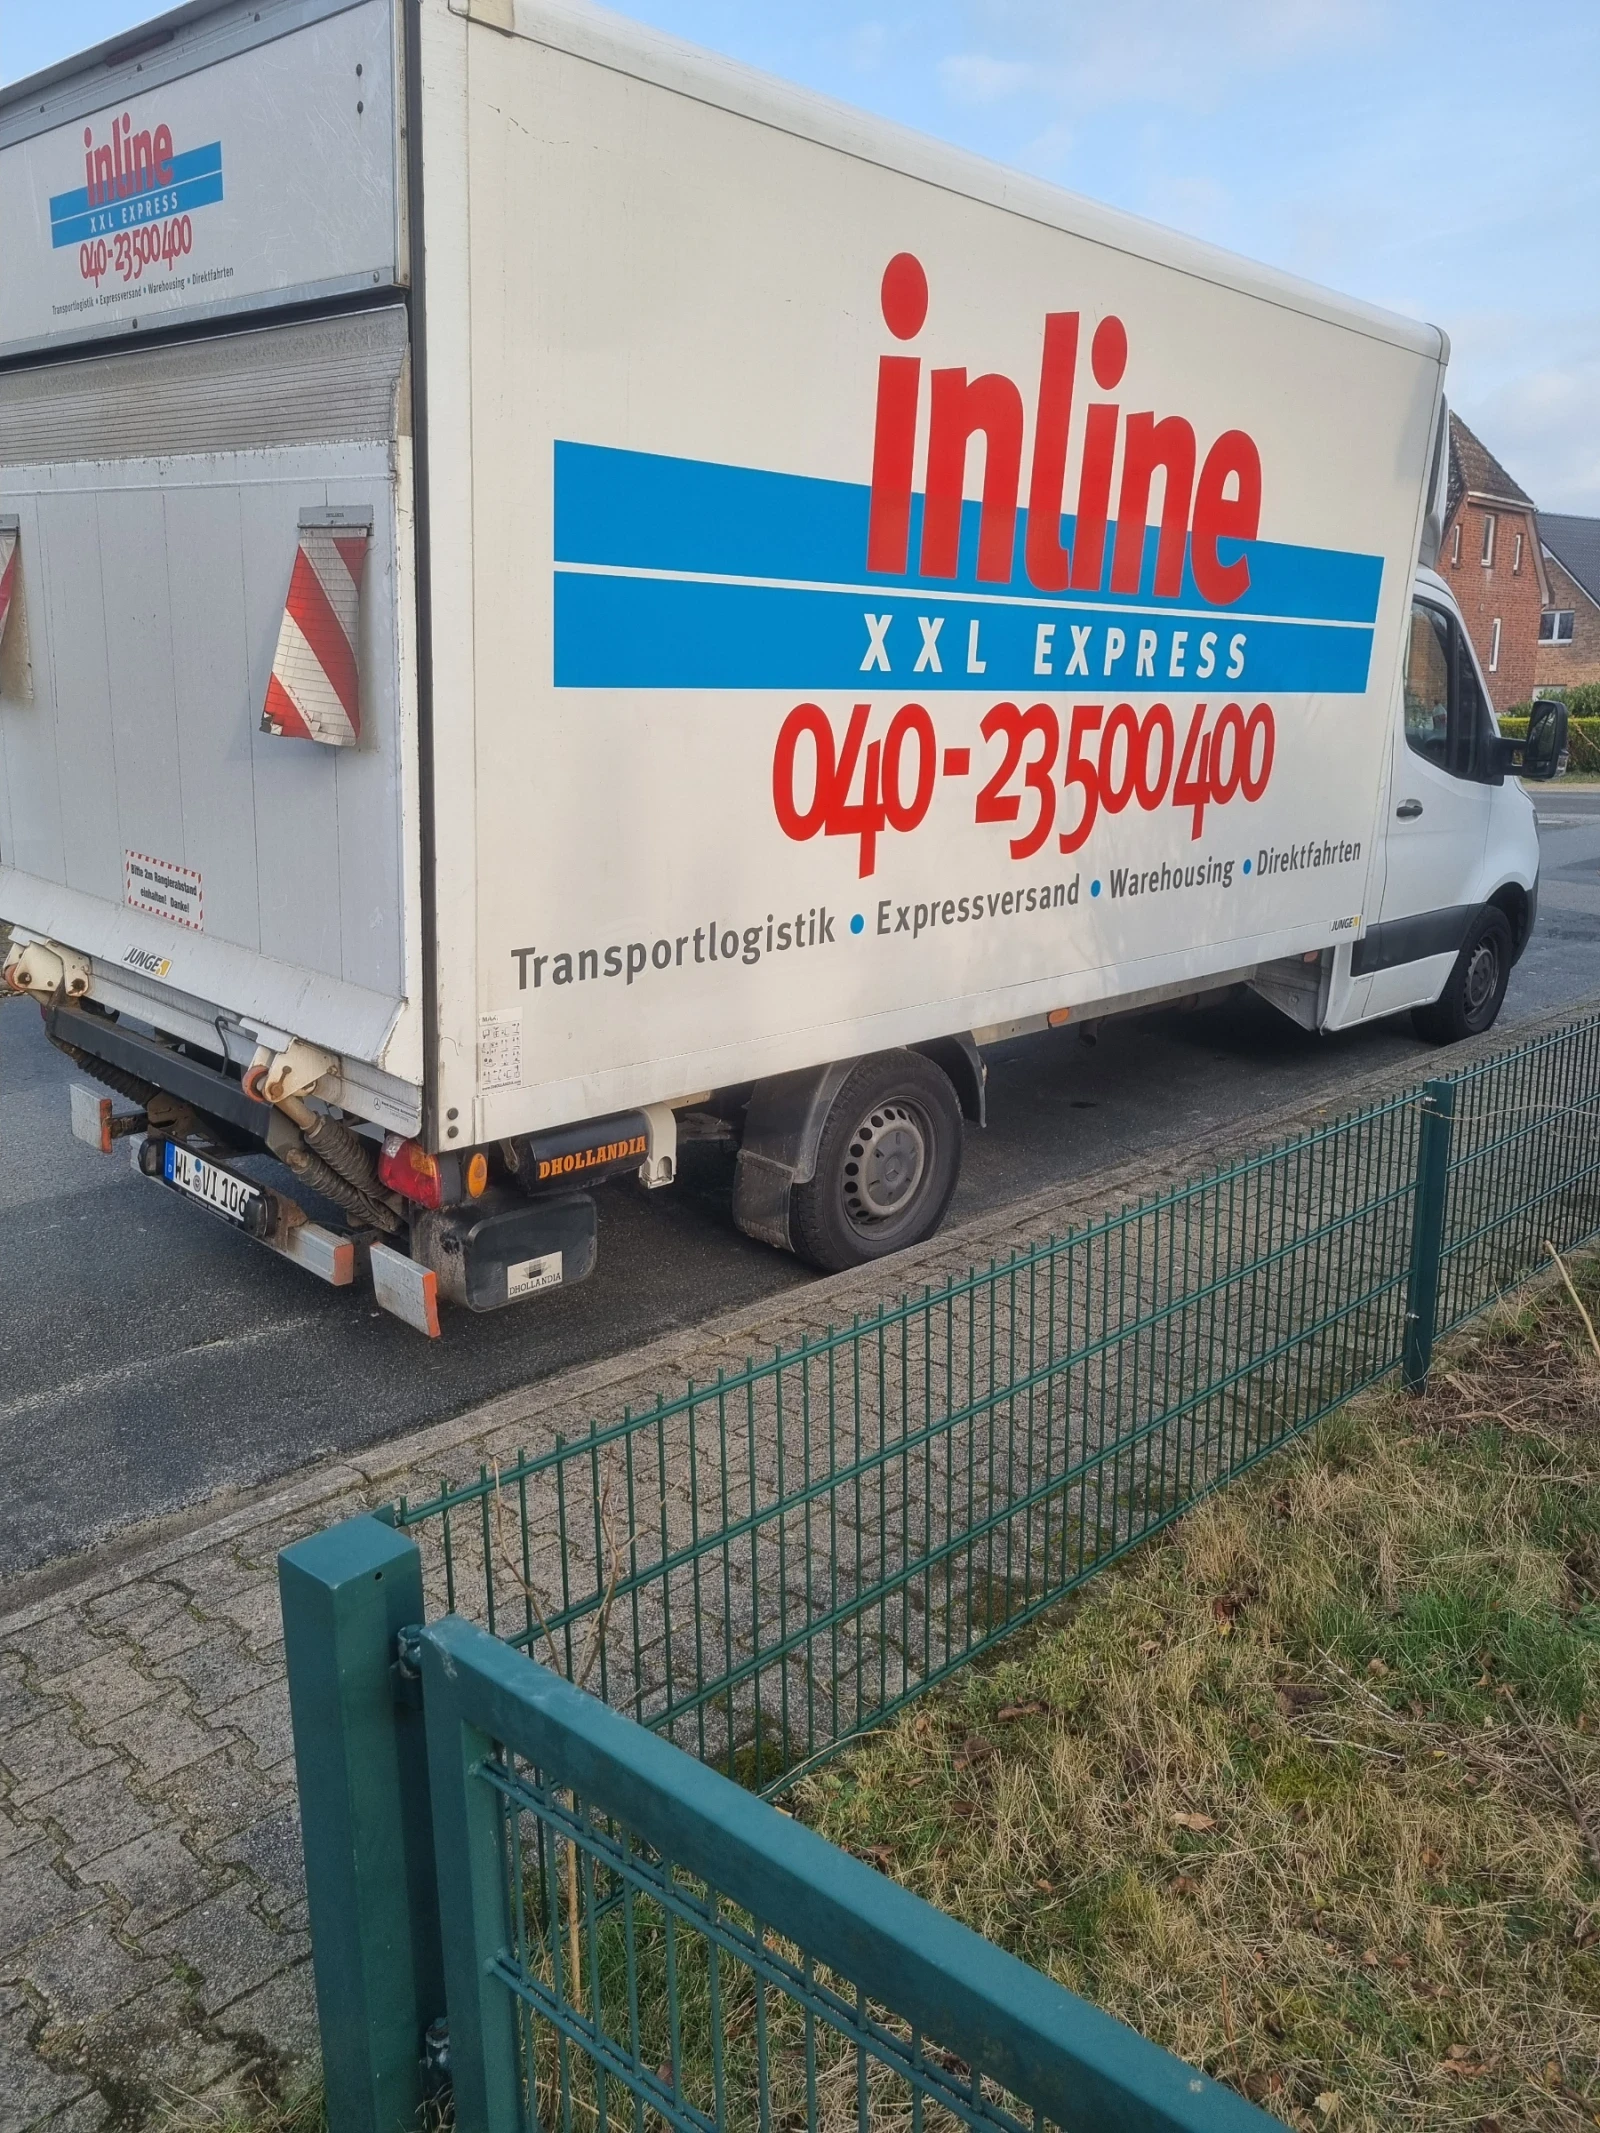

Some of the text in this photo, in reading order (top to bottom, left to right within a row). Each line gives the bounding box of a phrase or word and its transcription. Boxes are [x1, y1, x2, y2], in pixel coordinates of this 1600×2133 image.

[84, 112, 173, 207] inline
[90, 191, 178, 233] XXL EXPRESS
[80, 214, 192, 288] 040-23500400
[52, 266, 234, 316] Transportlogistik Expressversand Warehousing Direktfahrten
[866, 252, 1263, 607] inline
[859, 613, 1248, 679] XXL EXPRESS
[772, 701, 1275, 879] 040-23500400
[154, 871, 197, 896] Rangierabstand
[170, 896, 190, 913] Danke!
[511, 840, 1362, 990] Transportlogistik Expressversand Warehousing Direktfahrten
[1331, 917, 1354, 932] JUNGE
[124, 948, 162, 972] JUNGE
[538, 1135, 646, 1180] DHOLLANDIA
[175, 1150, 191, 1186] WL
[220, 1178, 247, 1217] 106
[509, 1272, 562, 1296] DHOLLANDIA
